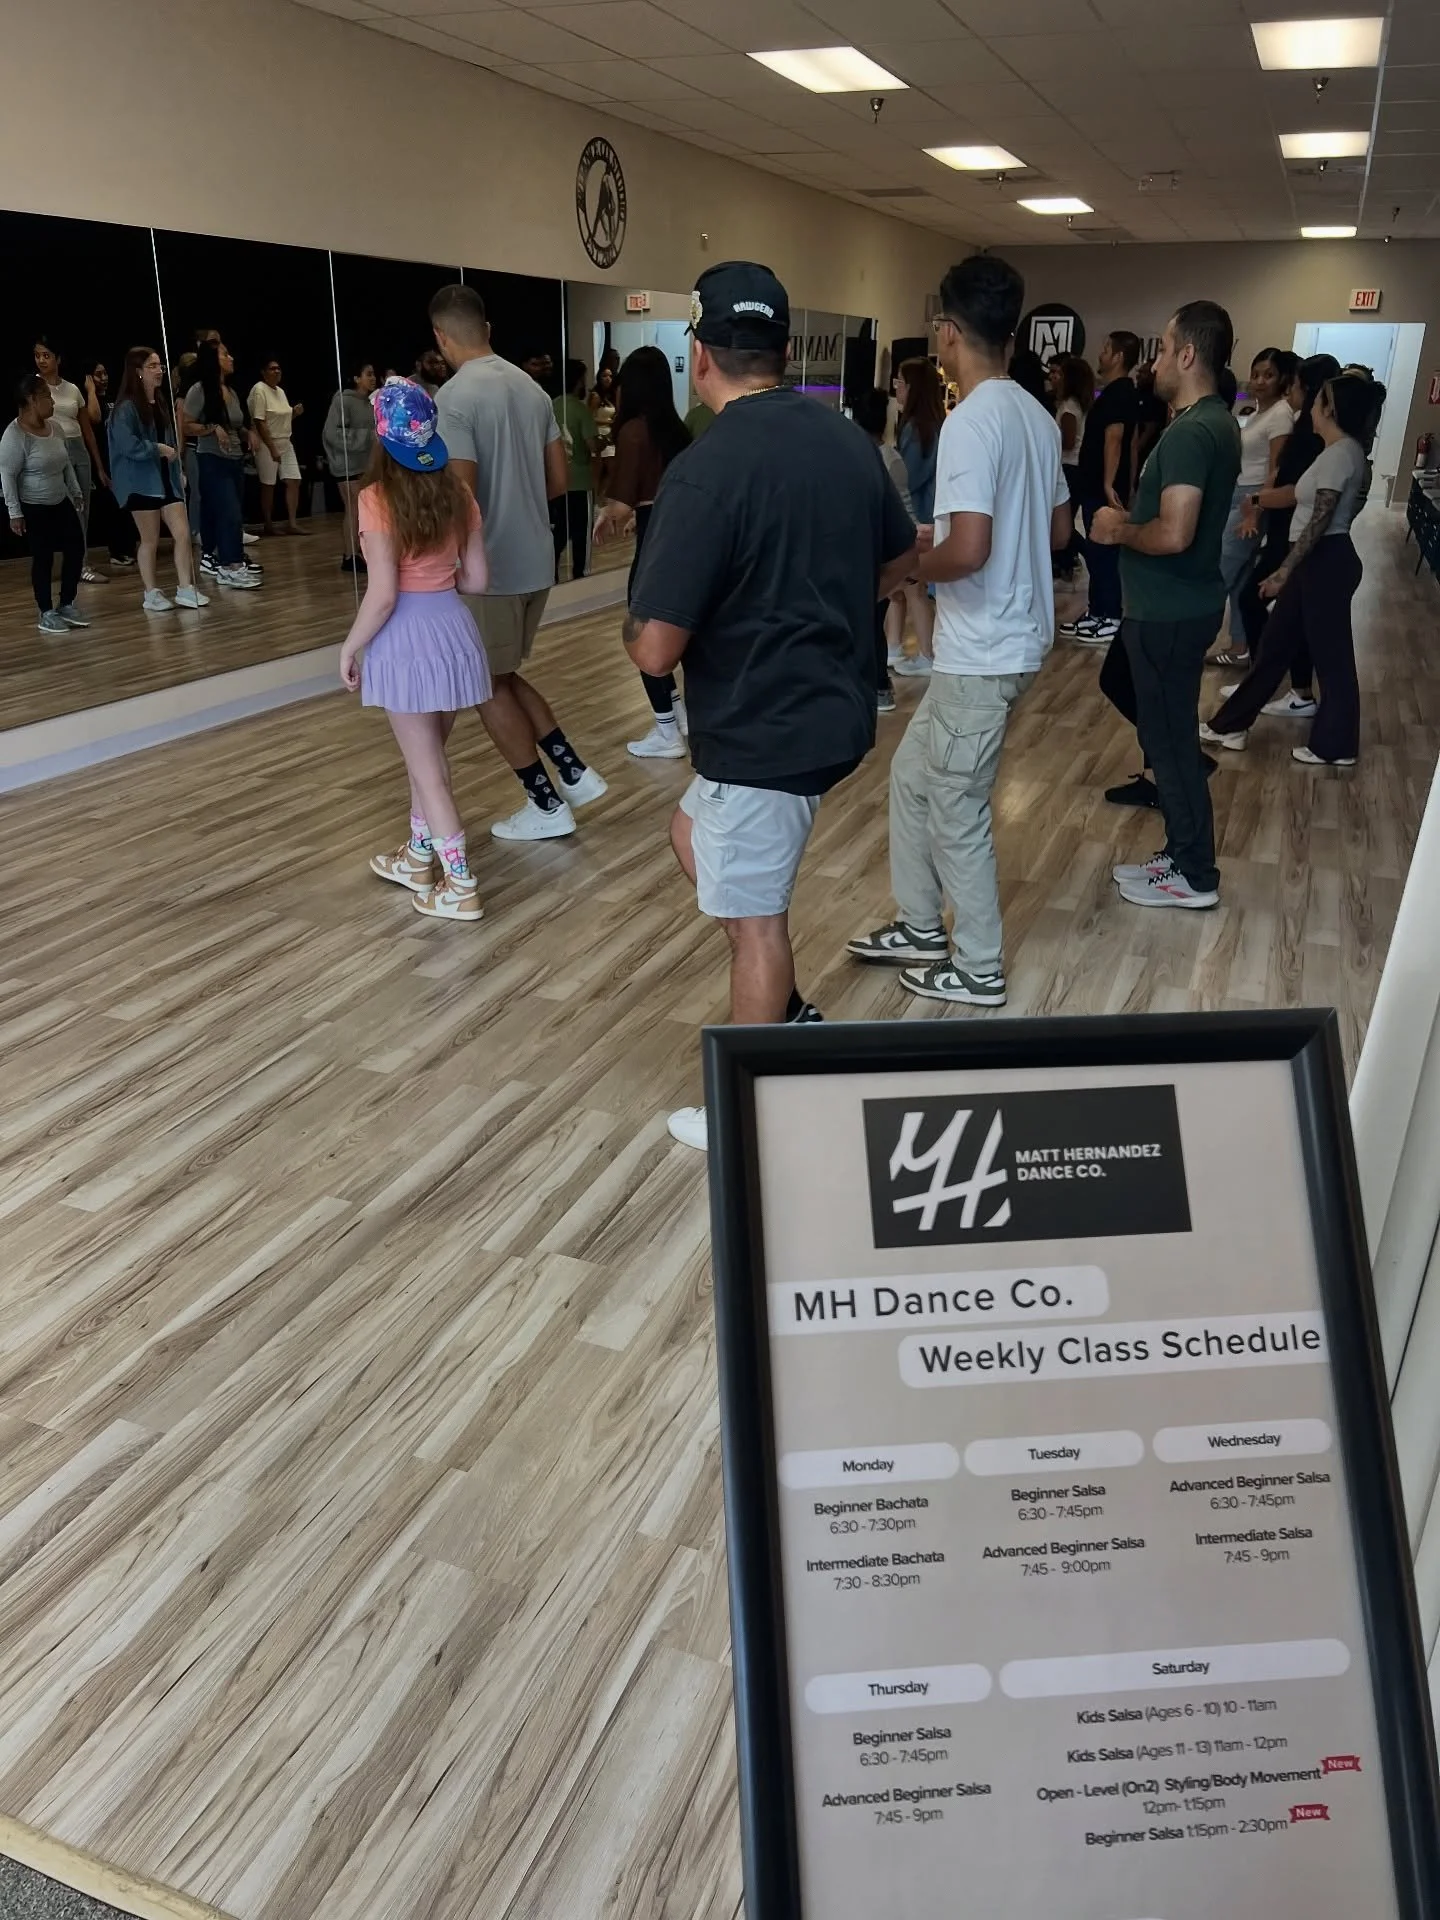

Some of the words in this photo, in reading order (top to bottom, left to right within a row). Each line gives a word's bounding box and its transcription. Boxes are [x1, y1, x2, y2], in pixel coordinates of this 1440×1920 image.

[1355, 291, 1376, 307] EXIT
[1016, 1149, 1061, 1163] MATT
[1064, 1144, 1162, 1161] HERNANDEZ
[1017, 1165, 1073, 1181] DANCE
[1076, 1164, 1107, 1178] CO.
[793, 1289, 857, 1321] MH
[872, 1282, 995, 1318] Dance
[1009, 1278, 1074, 1308] Co.
[919, 1338, 1045, 1374] Weekly
[1057, 1334, 1150, 1366] Class
[1161, 1325, 1321, 1359] Schedule
[1207, 1433, 1281, 1448] Wednesday
[1027, 1447, 1081, 1460] Tuesday
[842, 1459, 895, 1472] Monday
[1169, 1477, 1234, 1493] Advanced
[1236, 1474, 1294, 1490] Beginner
[1296, 1471, 1331, 1484] Salsa
[1011, 1487, 1070, 1503] Beginner
[1072, 1484, 1106, 1497] Salsa
[1210, 1496, 1238, 1510] 6:30
[1248, 1494, 1295, 1508] 7:45pm
[813, 1501, 872, 1516] Beginner
[875, 1496, 929, 1511] Bachata
[1018, 1507, 1046, 1521] 6:30
[1056, 1505, 1103, 1519] 7:45pm
[830, 1520, 858, 1534] 6:30
[868, 1517, 916, 1532] 7:30pm
[1195, 1529, 1276, 1545] Intermediate
[1279, 1527, 1313, 1540] Salsa
[982, 1543, 1047, 1559] Advanced
[1050, 1540, 1109, 1555] Beginner
[1111, 1537, 1145, 1550] Salsa
[1224, 1550, 1250, 1564] 7:45
[1260, 1548, 1290, 1563] 9pm
[806, 1556, 888, 1572] Intermediate
[891, 1551, 945, 1566] Bachata
[1020, 1562, 1048, 1577] 7:45
[1061, 1559, 1111, 1574] 9:00pm
[833, 1576, 861, 1590] 7:30
[872, 1573, 920, 1588] 8:30pm
[1152, 1660, 1210, 1675] Saturday
[867, 1681, 929, 1696] Thursday
[1076, 1709, 1105, 1724] Kids
[1107, 1708, 1143, 1722] Salsa
[1145, 1705, 1182, 1722] (Ages
[1184, 1703, 1194, 1717] 6
[1203, 1702, 1221, 1717] 10)
[1224, 1700, 1238, 1714] 10
[1248, 1699, 1277, 1712] 11am
[853, 1730, 913, 1747] Beginner
[916, 1726, 952, 1740] Salsa
[859, 1751, 889, 1767] 6:30
[899, 1748, 949, 1764] 7:45pm
[1067, 1749, 1096, 1763] Kids
[1098, 1747, 1134, 1762] Salsa
[1136, 1745, 1173, 1762] (Ages
[1175, 1742, 1185, 1755] 11
[1195, 1740, 1212, 1756] 13)
[1214, 1739, 1244, 1753] 11am
[1253, 1736, 1288, 1751] 12pm
[1327, 1757, 1354, 1769] New
[1036, 1787, 1074, 1803] Open
[1083, 1782, 1120, 1797] Level
[1122, 1779, 1160, 1797] (On2)
[1250, 1767, 1322, 1785] Movement
[821, 1789, 890, 1807] Advanced
[893, 1785, 953, 1803] Beginner
[956, 1782, 992, 1796] Salsa
[873, 1809, 902, 1825] 7:45
[912, 1808, 943, 1824] 9pm
[1295, 1807, 1322, 1818] New
[1085, 1830, 1146, 1847] Beginner
[1148, 1826, 1184, 1841] Salsa
[1238, 1818, 1288, 1834] 2:30pm
